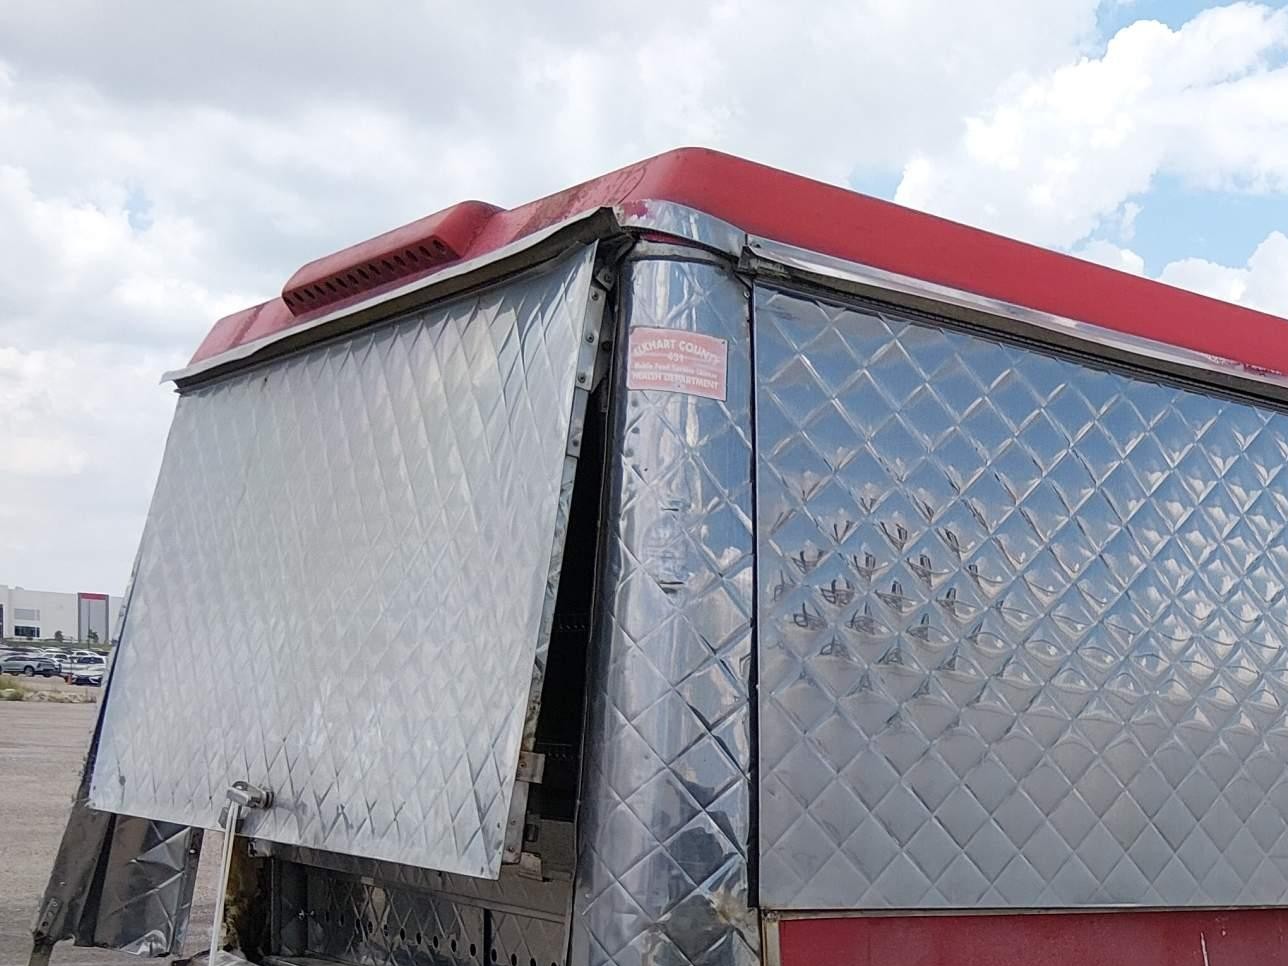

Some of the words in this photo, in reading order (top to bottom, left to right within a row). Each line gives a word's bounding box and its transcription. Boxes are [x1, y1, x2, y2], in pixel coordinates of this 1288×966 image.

[633, 339, 675, 355] ELKHART
[679, 340, 720, 365] COUNTY
[632, 371, 662, 381] HEALTH
[663, 374, 719, 389] DEPARTMENT
